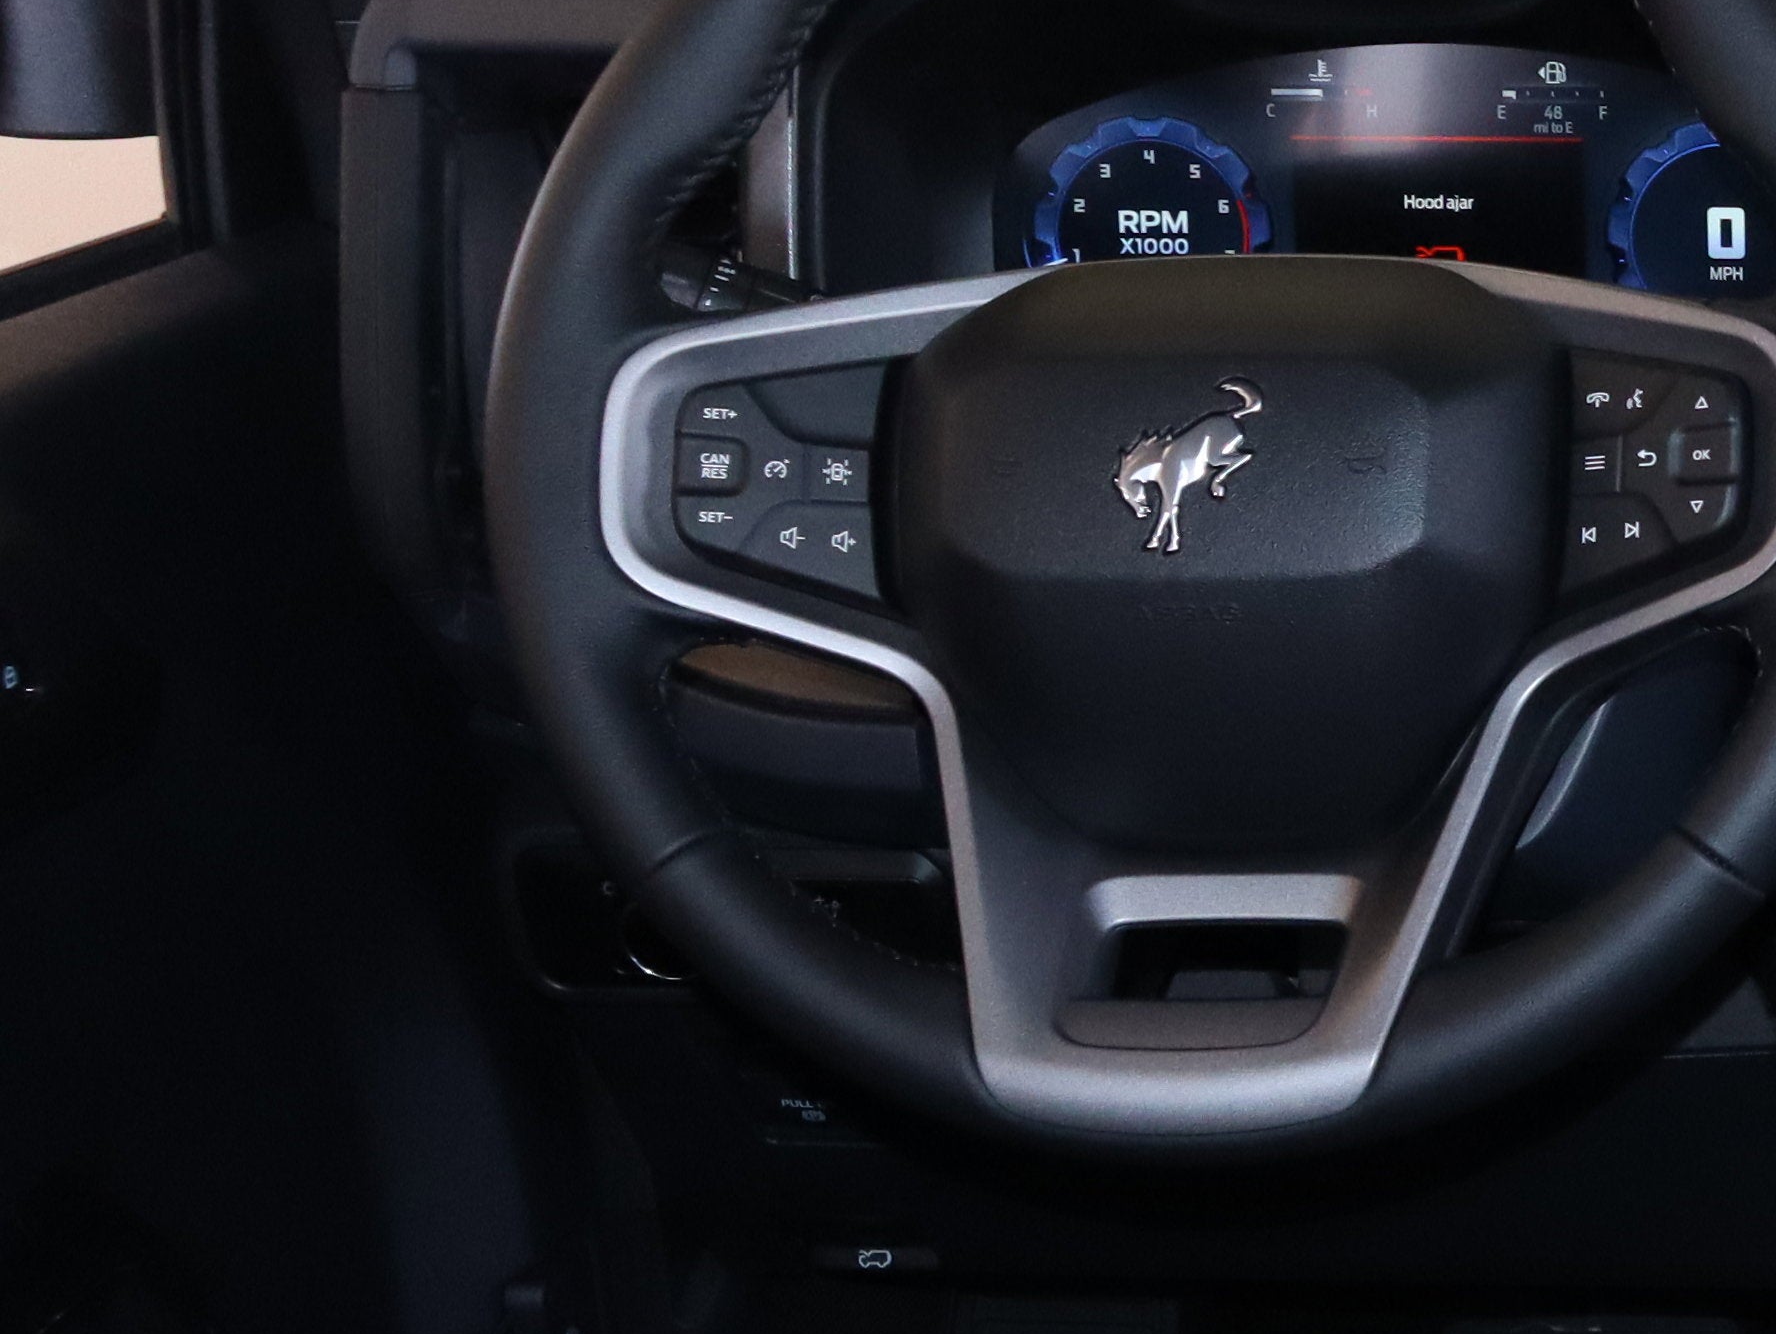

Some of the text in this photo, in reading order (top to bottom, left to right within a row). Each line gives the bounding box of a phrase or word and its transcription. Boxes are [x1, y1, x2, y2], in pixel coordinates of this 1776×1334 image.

[1266, 104, 1275, 118] C
[1366, 105, 1378, 118] H
[1497, 105, 1507, 119] E
[1544, 105, 1563, 120] 48
[1599, 105, 1608, 120] F
[1533, 122, 1574, 134] mi to E
[1144, 150, 1155, 164] 4
[1099, 164, 1111, 179] 3
[1189, 164, 1201, 179] 5
[1073, 198, 1086, 213] 2
[1218, 199, 1230, 214] 6
[1404, 195, 1475, 213] Hood ajar
[1117, 210, 1189, 234] RPM
[1706, 206, 1746, 261] 0
[1119, 237, 1189, 255] X1000
[1072, 248, 1081, 264] 1
[1709, 266, 1745, 282] MPH
[700, 453, 730, 464] CAN
[1692, 449, 1711, 461] OK
[701, 468, 728, 479] RES
